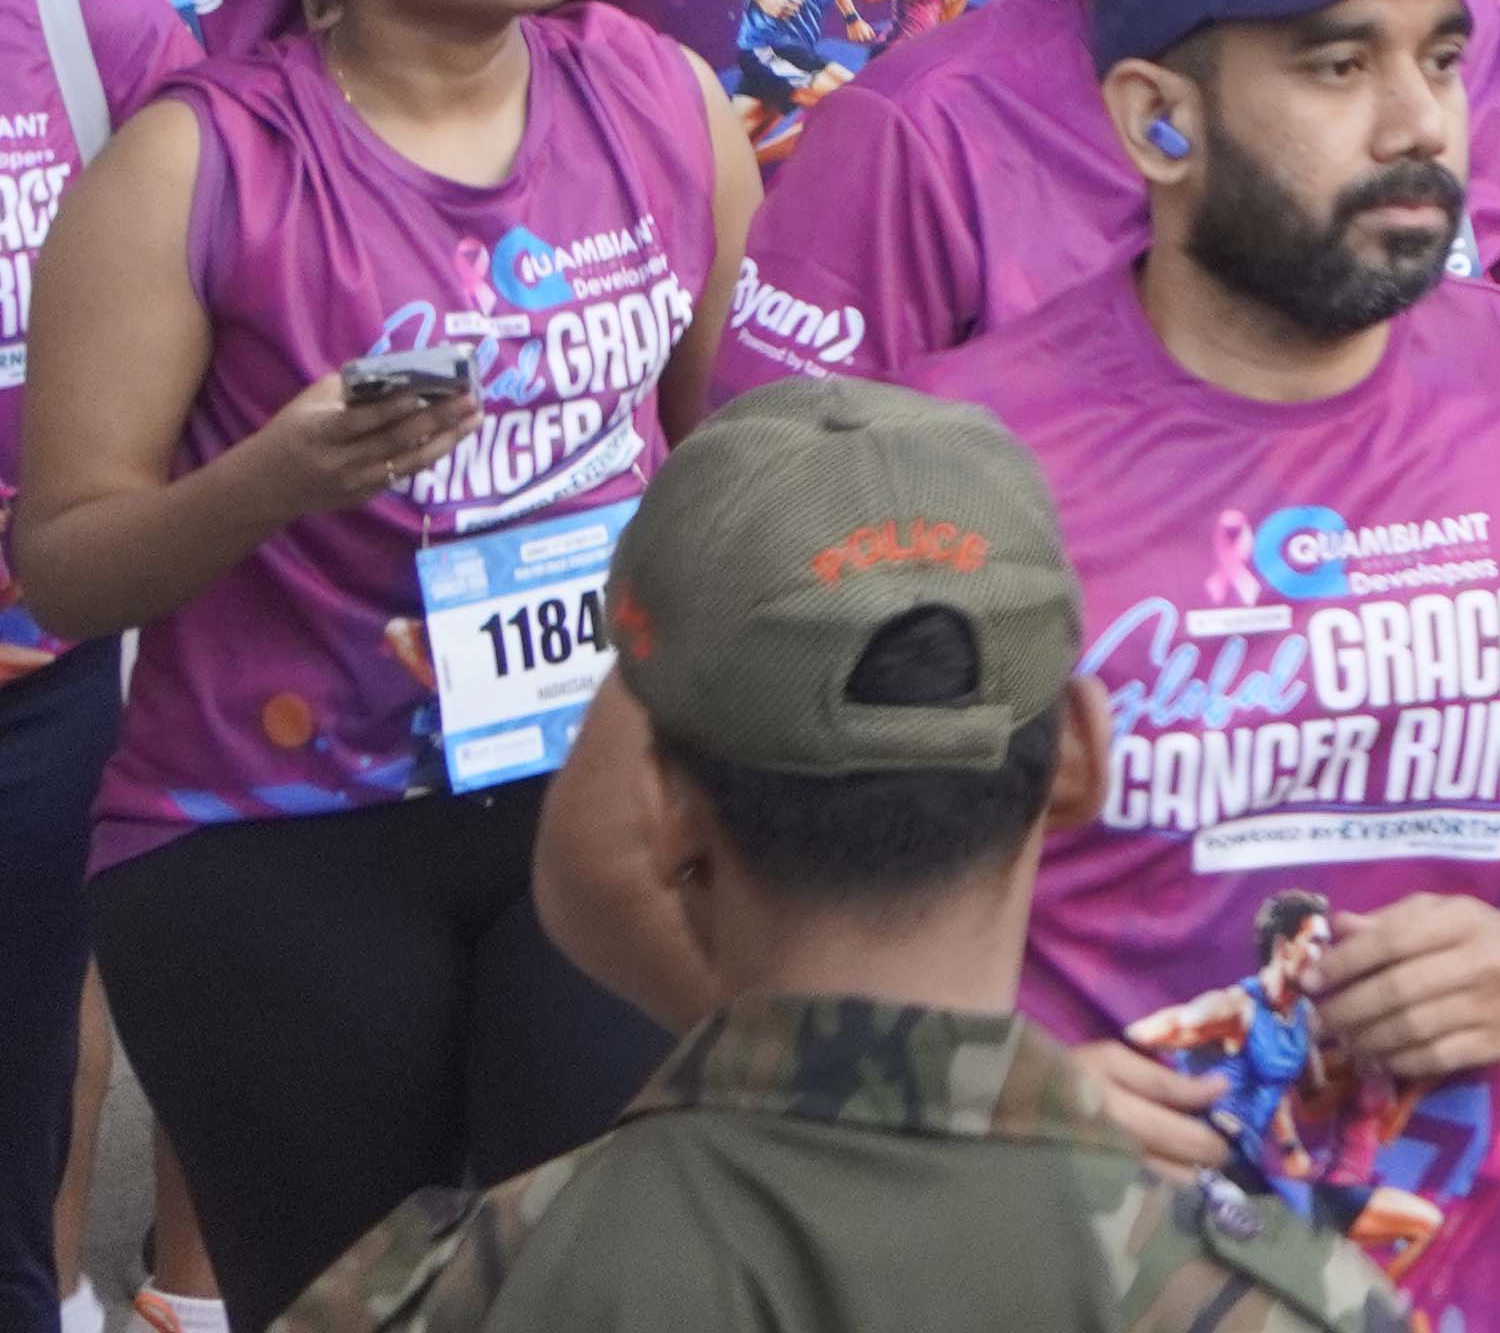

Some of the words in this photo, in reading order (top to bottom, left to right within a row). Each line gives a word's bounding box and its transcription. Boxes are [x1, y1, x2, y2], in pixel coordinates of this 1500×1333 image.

[811, 518, 987, 585] POLICE
[1288, 513, 1489, 566] QUAMBIANT
[1350, 558, 1498, 596] Developers
[1078, 598, 1308, 731] Global
[1103, 718, 1380, 833] CANCER
